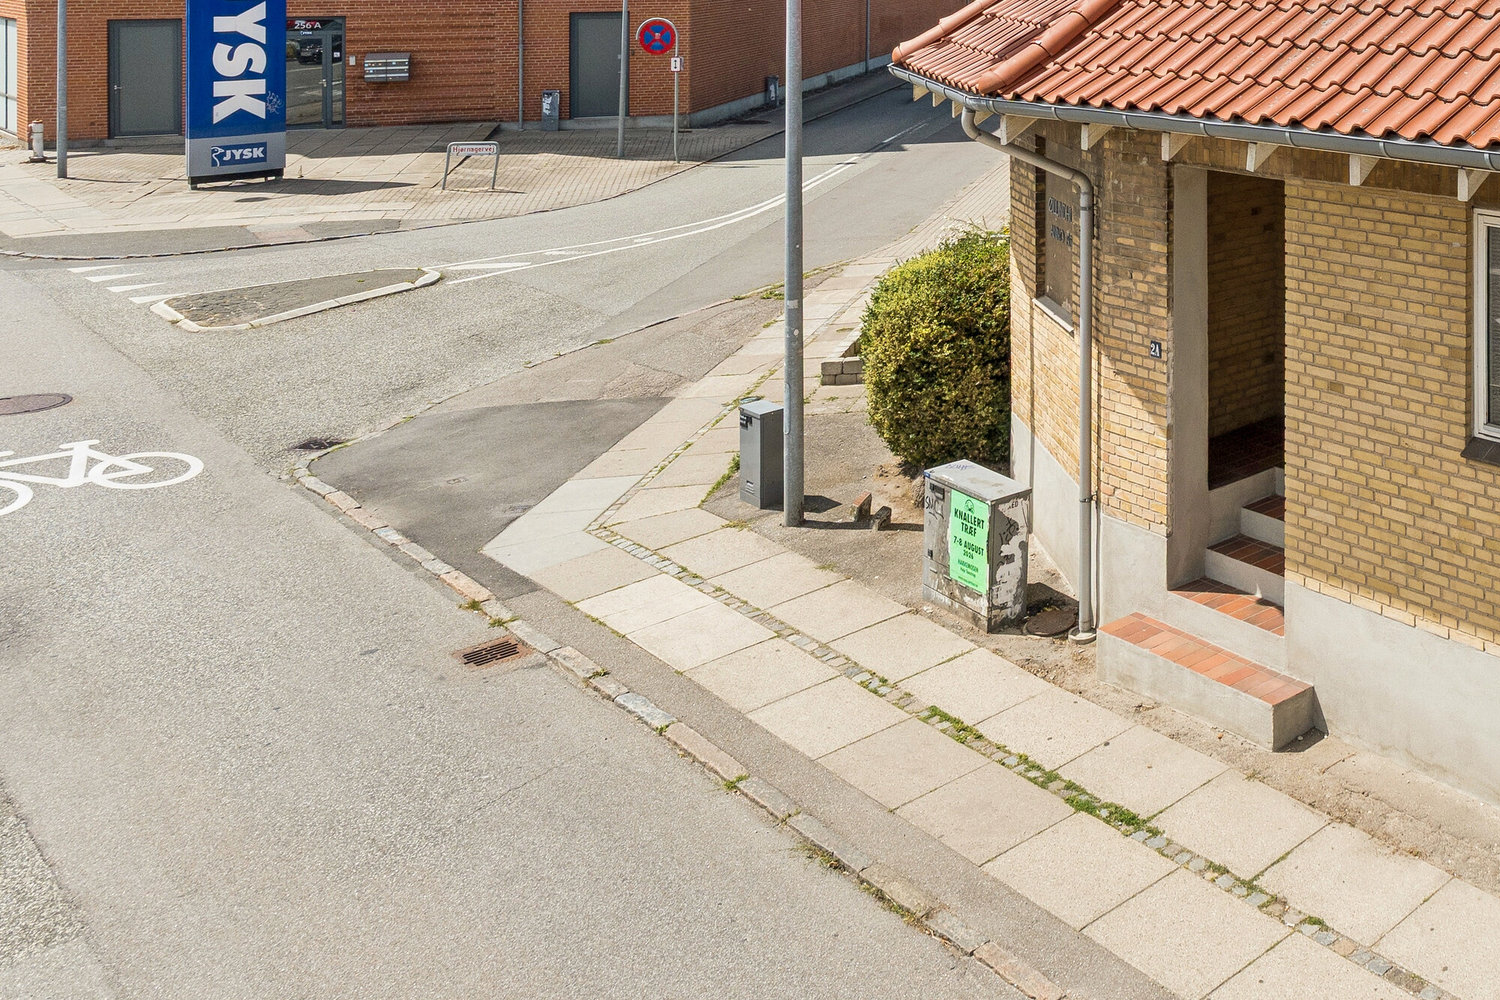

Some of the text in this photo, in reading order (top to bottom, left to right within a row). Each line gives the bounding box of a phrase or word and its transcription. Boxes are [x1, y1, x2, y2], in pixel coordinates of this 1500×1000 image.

[294, 20, 322, 30] 256 A
[223, 146, 265, 161] JYSK
[954, 507, 985, 530] KNALLERT
[961, 521, 977, 538] TRÆF
[963, 540, 984, 555] AUGUST
